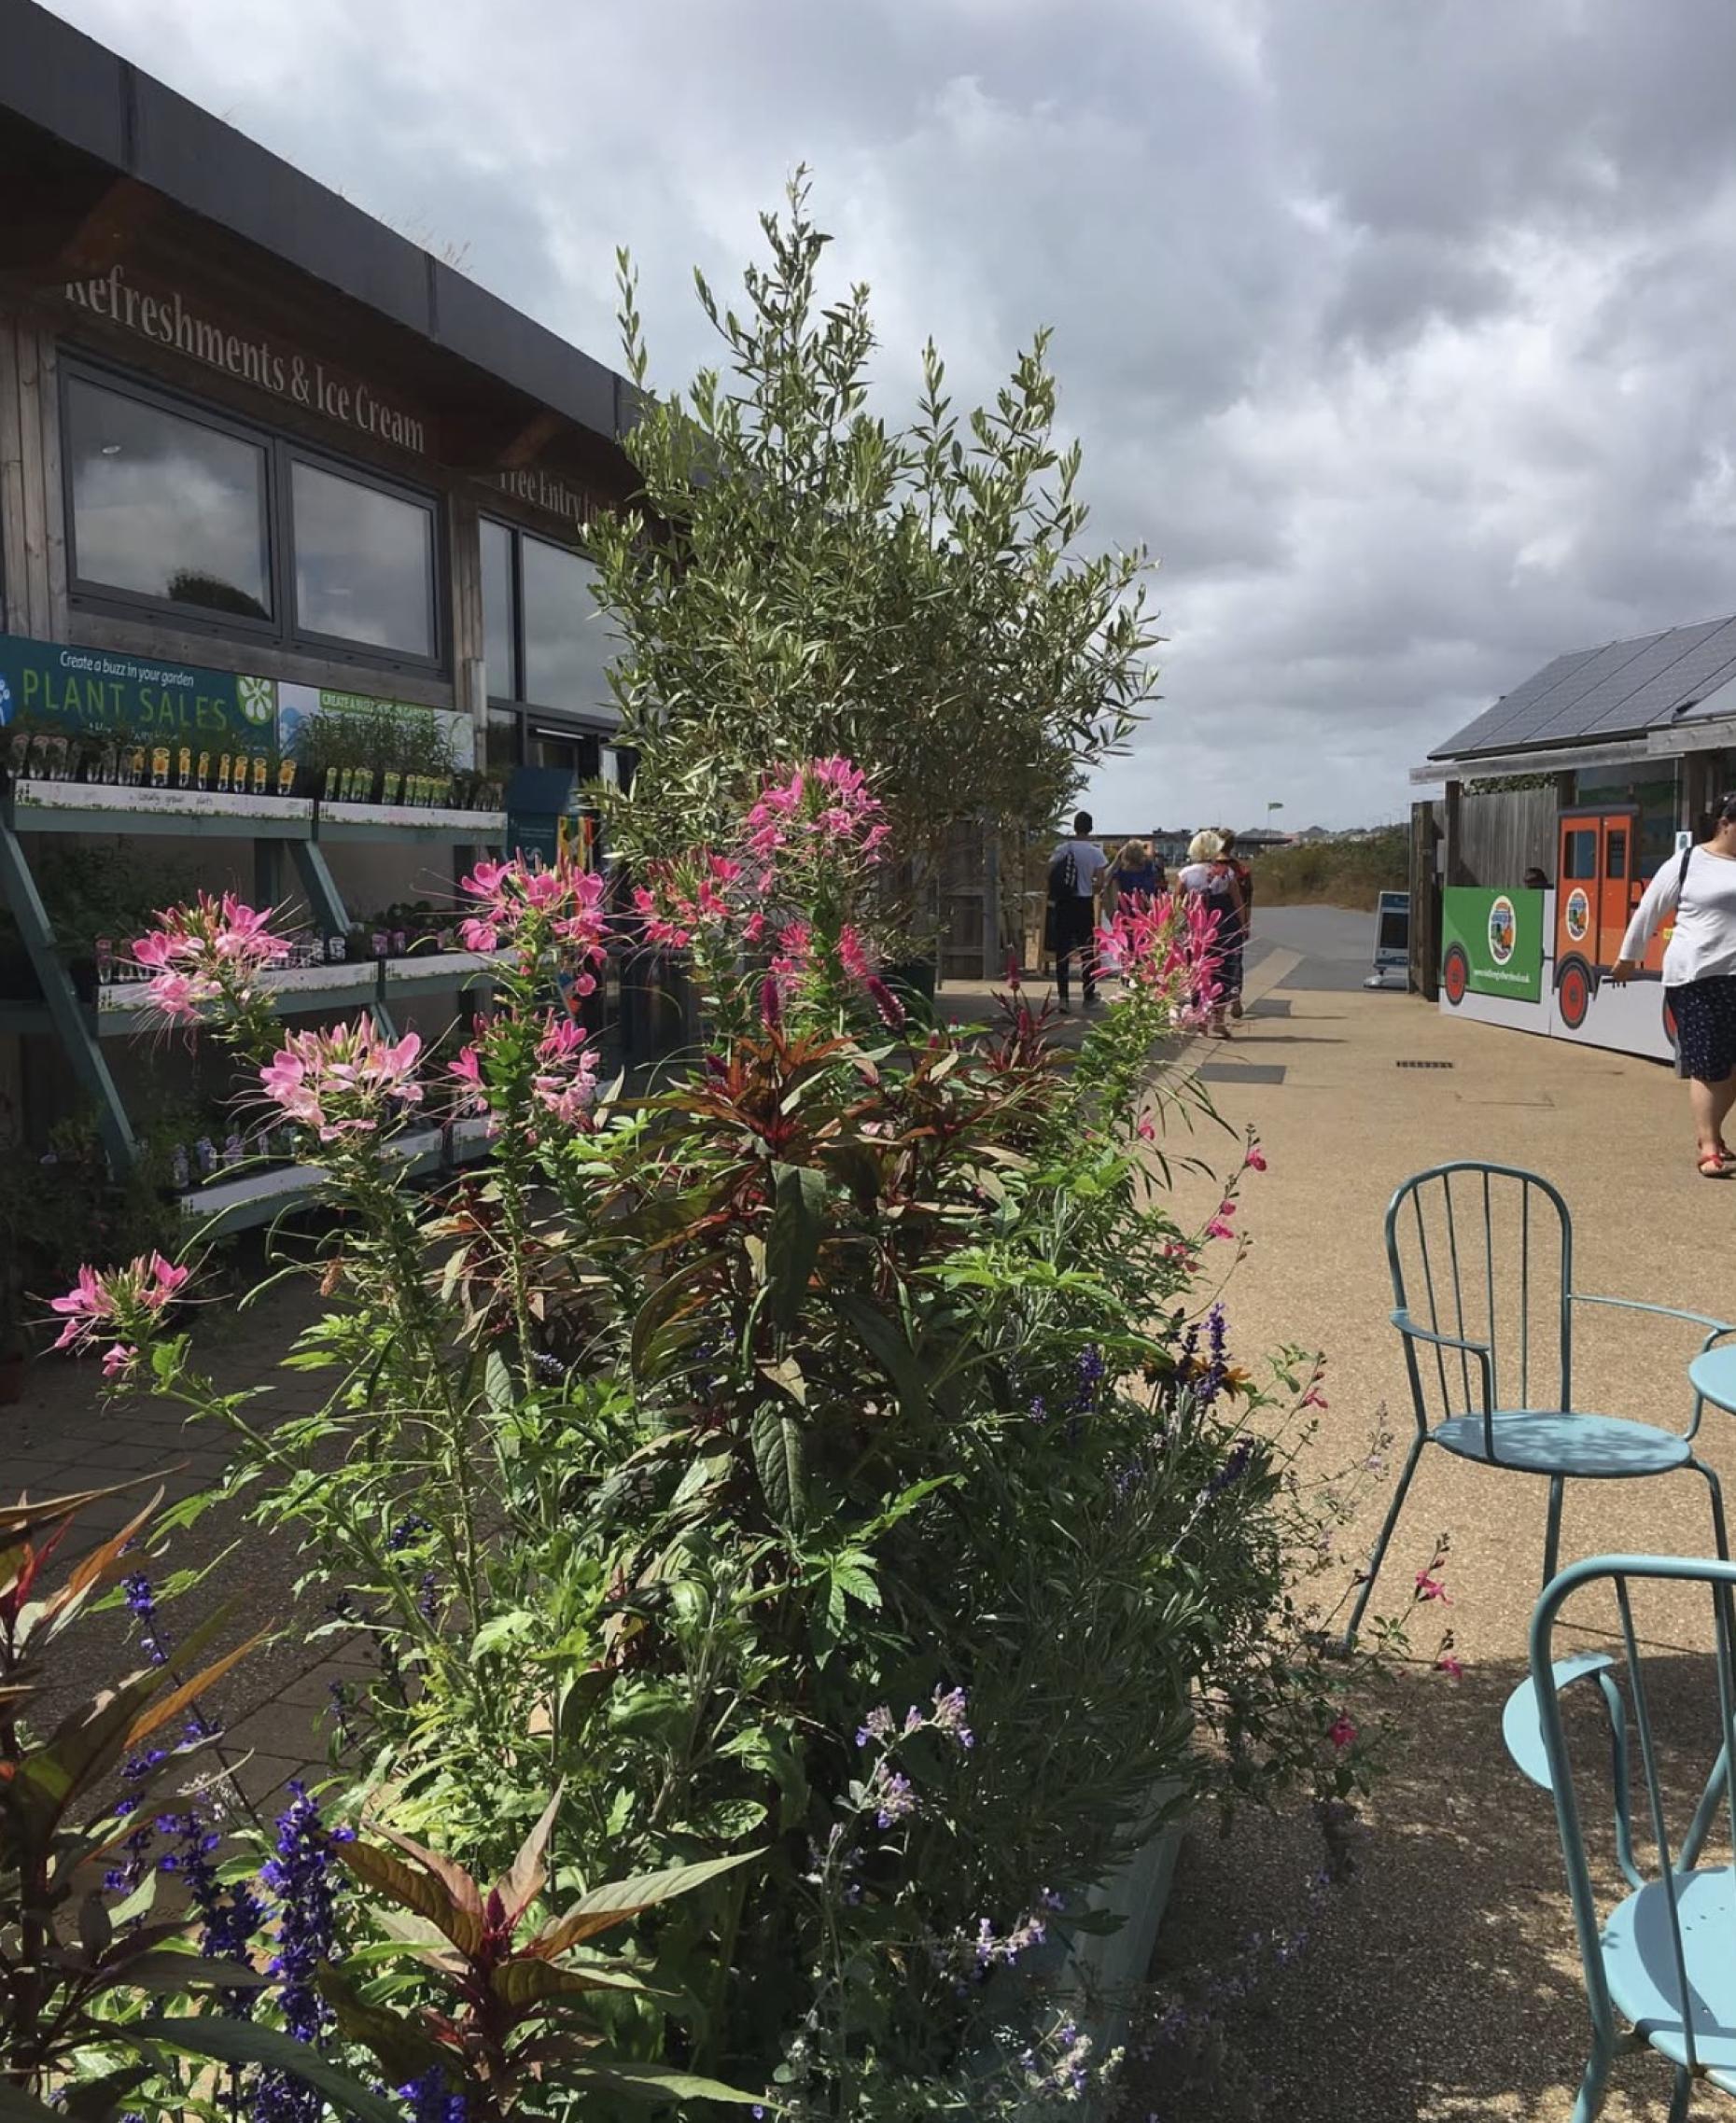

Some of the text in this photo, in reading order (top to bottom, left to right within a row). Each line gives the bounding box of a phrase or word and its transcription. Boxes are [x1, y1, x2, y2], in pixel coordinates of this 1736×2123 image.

[291, 355, 311, 406] &
[315, 362, 350, 421] Ice
[355, 383, 425, 454] Cream
[22, 668, 227, 732] PLANT SALES
[60, 649, 194, 688] Create a buzz in your garden
